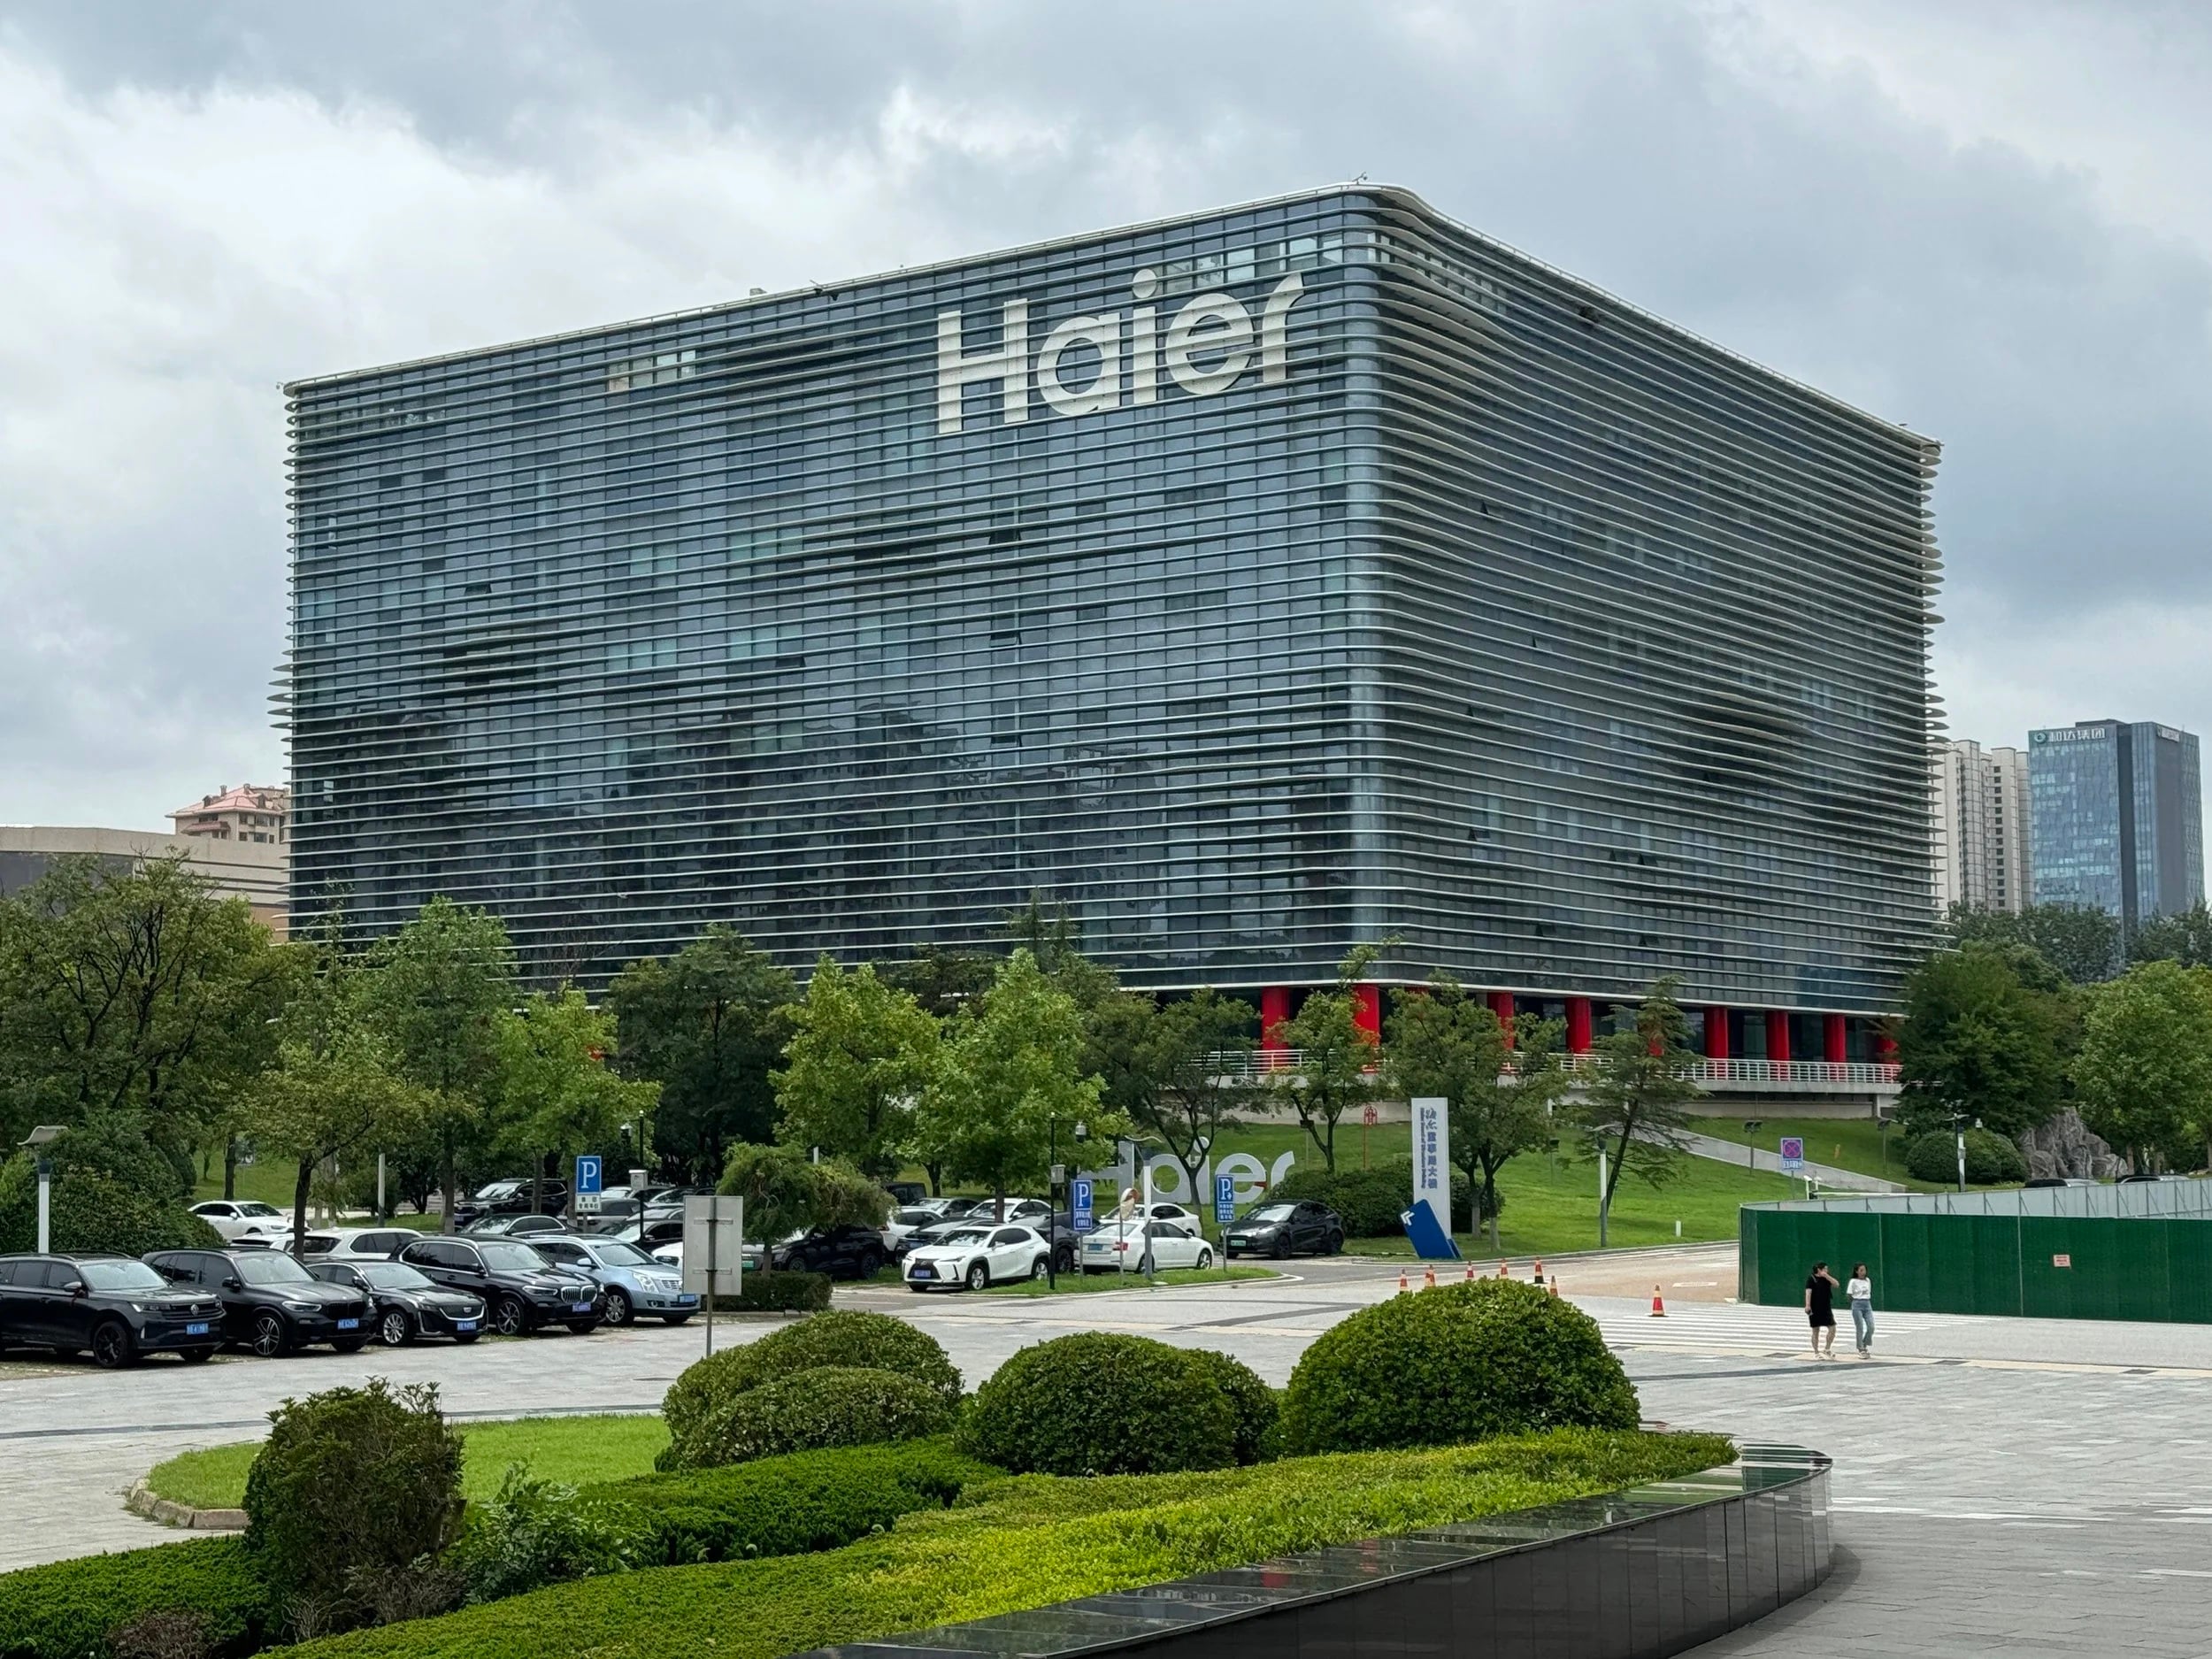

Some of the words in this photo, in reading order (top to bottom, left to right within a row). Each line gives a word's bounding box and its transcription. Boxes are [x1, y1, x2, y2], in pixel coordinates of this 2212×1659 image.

[938, 268, 1305, 434] Haier
[580, 1161, 597, 1188] P
[1078, 1183, 1089, 1207] P
[1220, 1178, 1231, 1200] P
